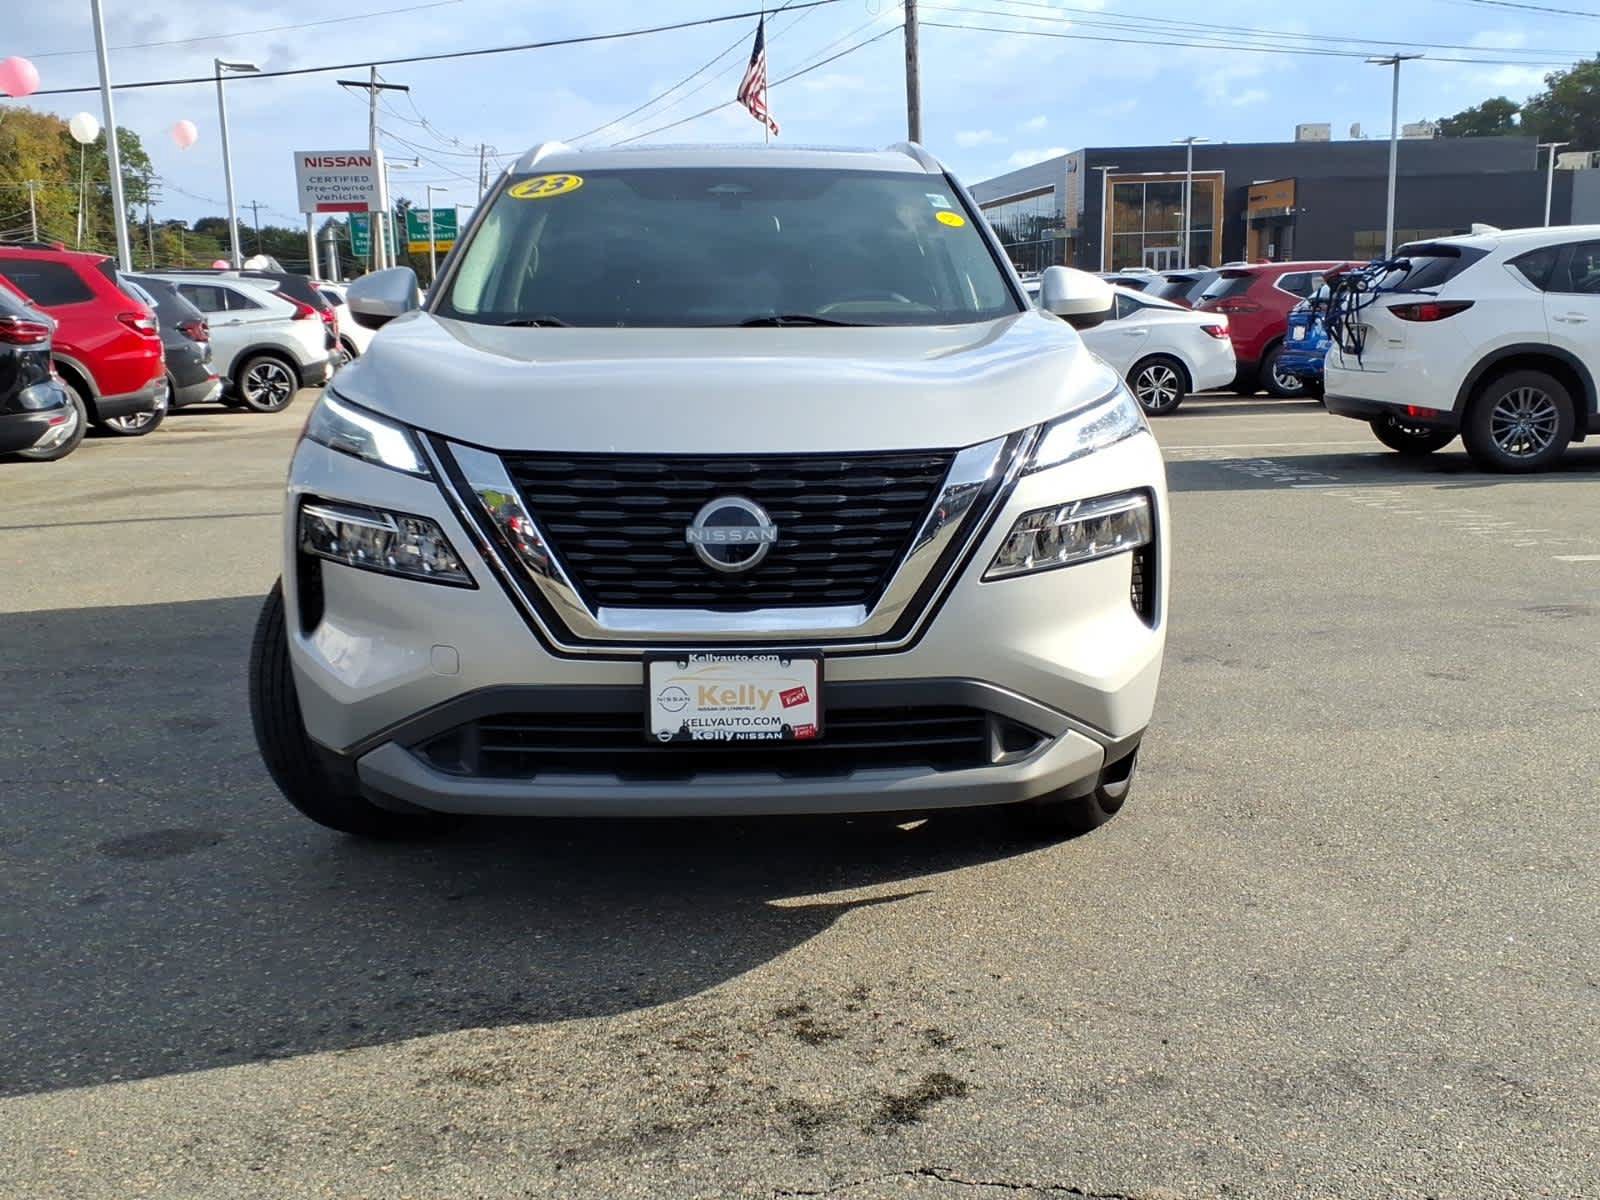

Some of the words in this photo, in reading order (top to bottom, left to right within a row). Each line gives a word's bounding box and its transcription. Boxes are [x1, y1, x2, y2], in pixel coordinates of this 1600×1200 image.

[304, 156, 372, 168] NISSAN
[309, 176, 369, 184] CERTIFIED
[305, 184, 374, 193] Pre-Owned
[520, 176, 569, 195] 23
[315, 193, 367, 201] Vehicles
[688, 529, 775, 541] NISSAN
[689, 653, 780, 663] Kellyauto.com
[697, 684, 774, 712] Kelly
[682, 717, 782, 727] KELLYAUTO.COM
[692, 731, 735, 741] Kelly
[736, 732, 783, 740] NISSAN
